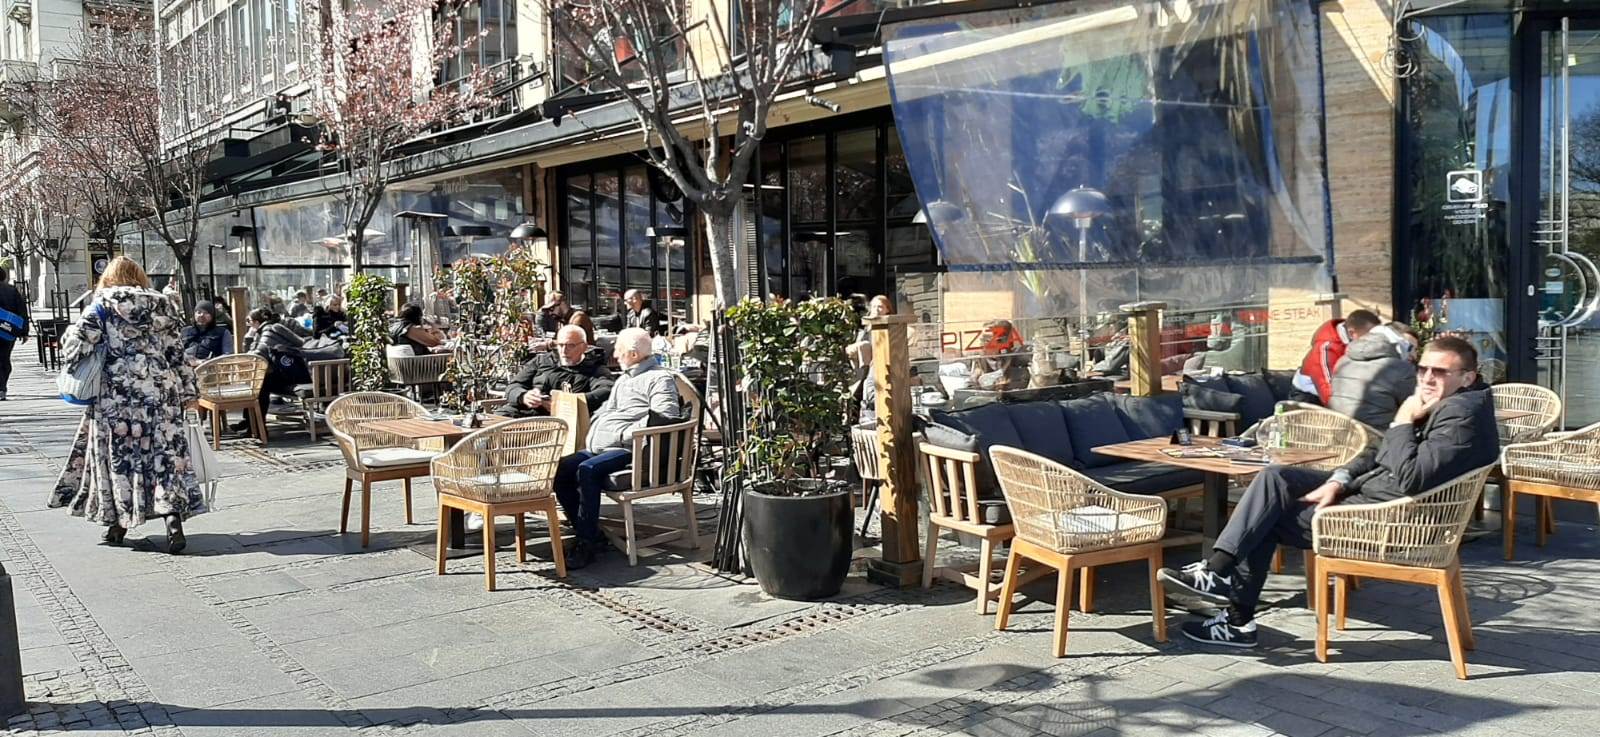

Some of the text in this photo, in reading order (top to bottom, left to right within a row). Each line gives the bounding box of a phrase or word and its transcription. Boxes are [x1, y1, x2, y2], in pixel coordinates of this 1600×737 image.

[940, 326, 1024, 355] PIZZA
[1193, 571, 1217, 591] AX
[1210, 624, 1235, 641] AX
